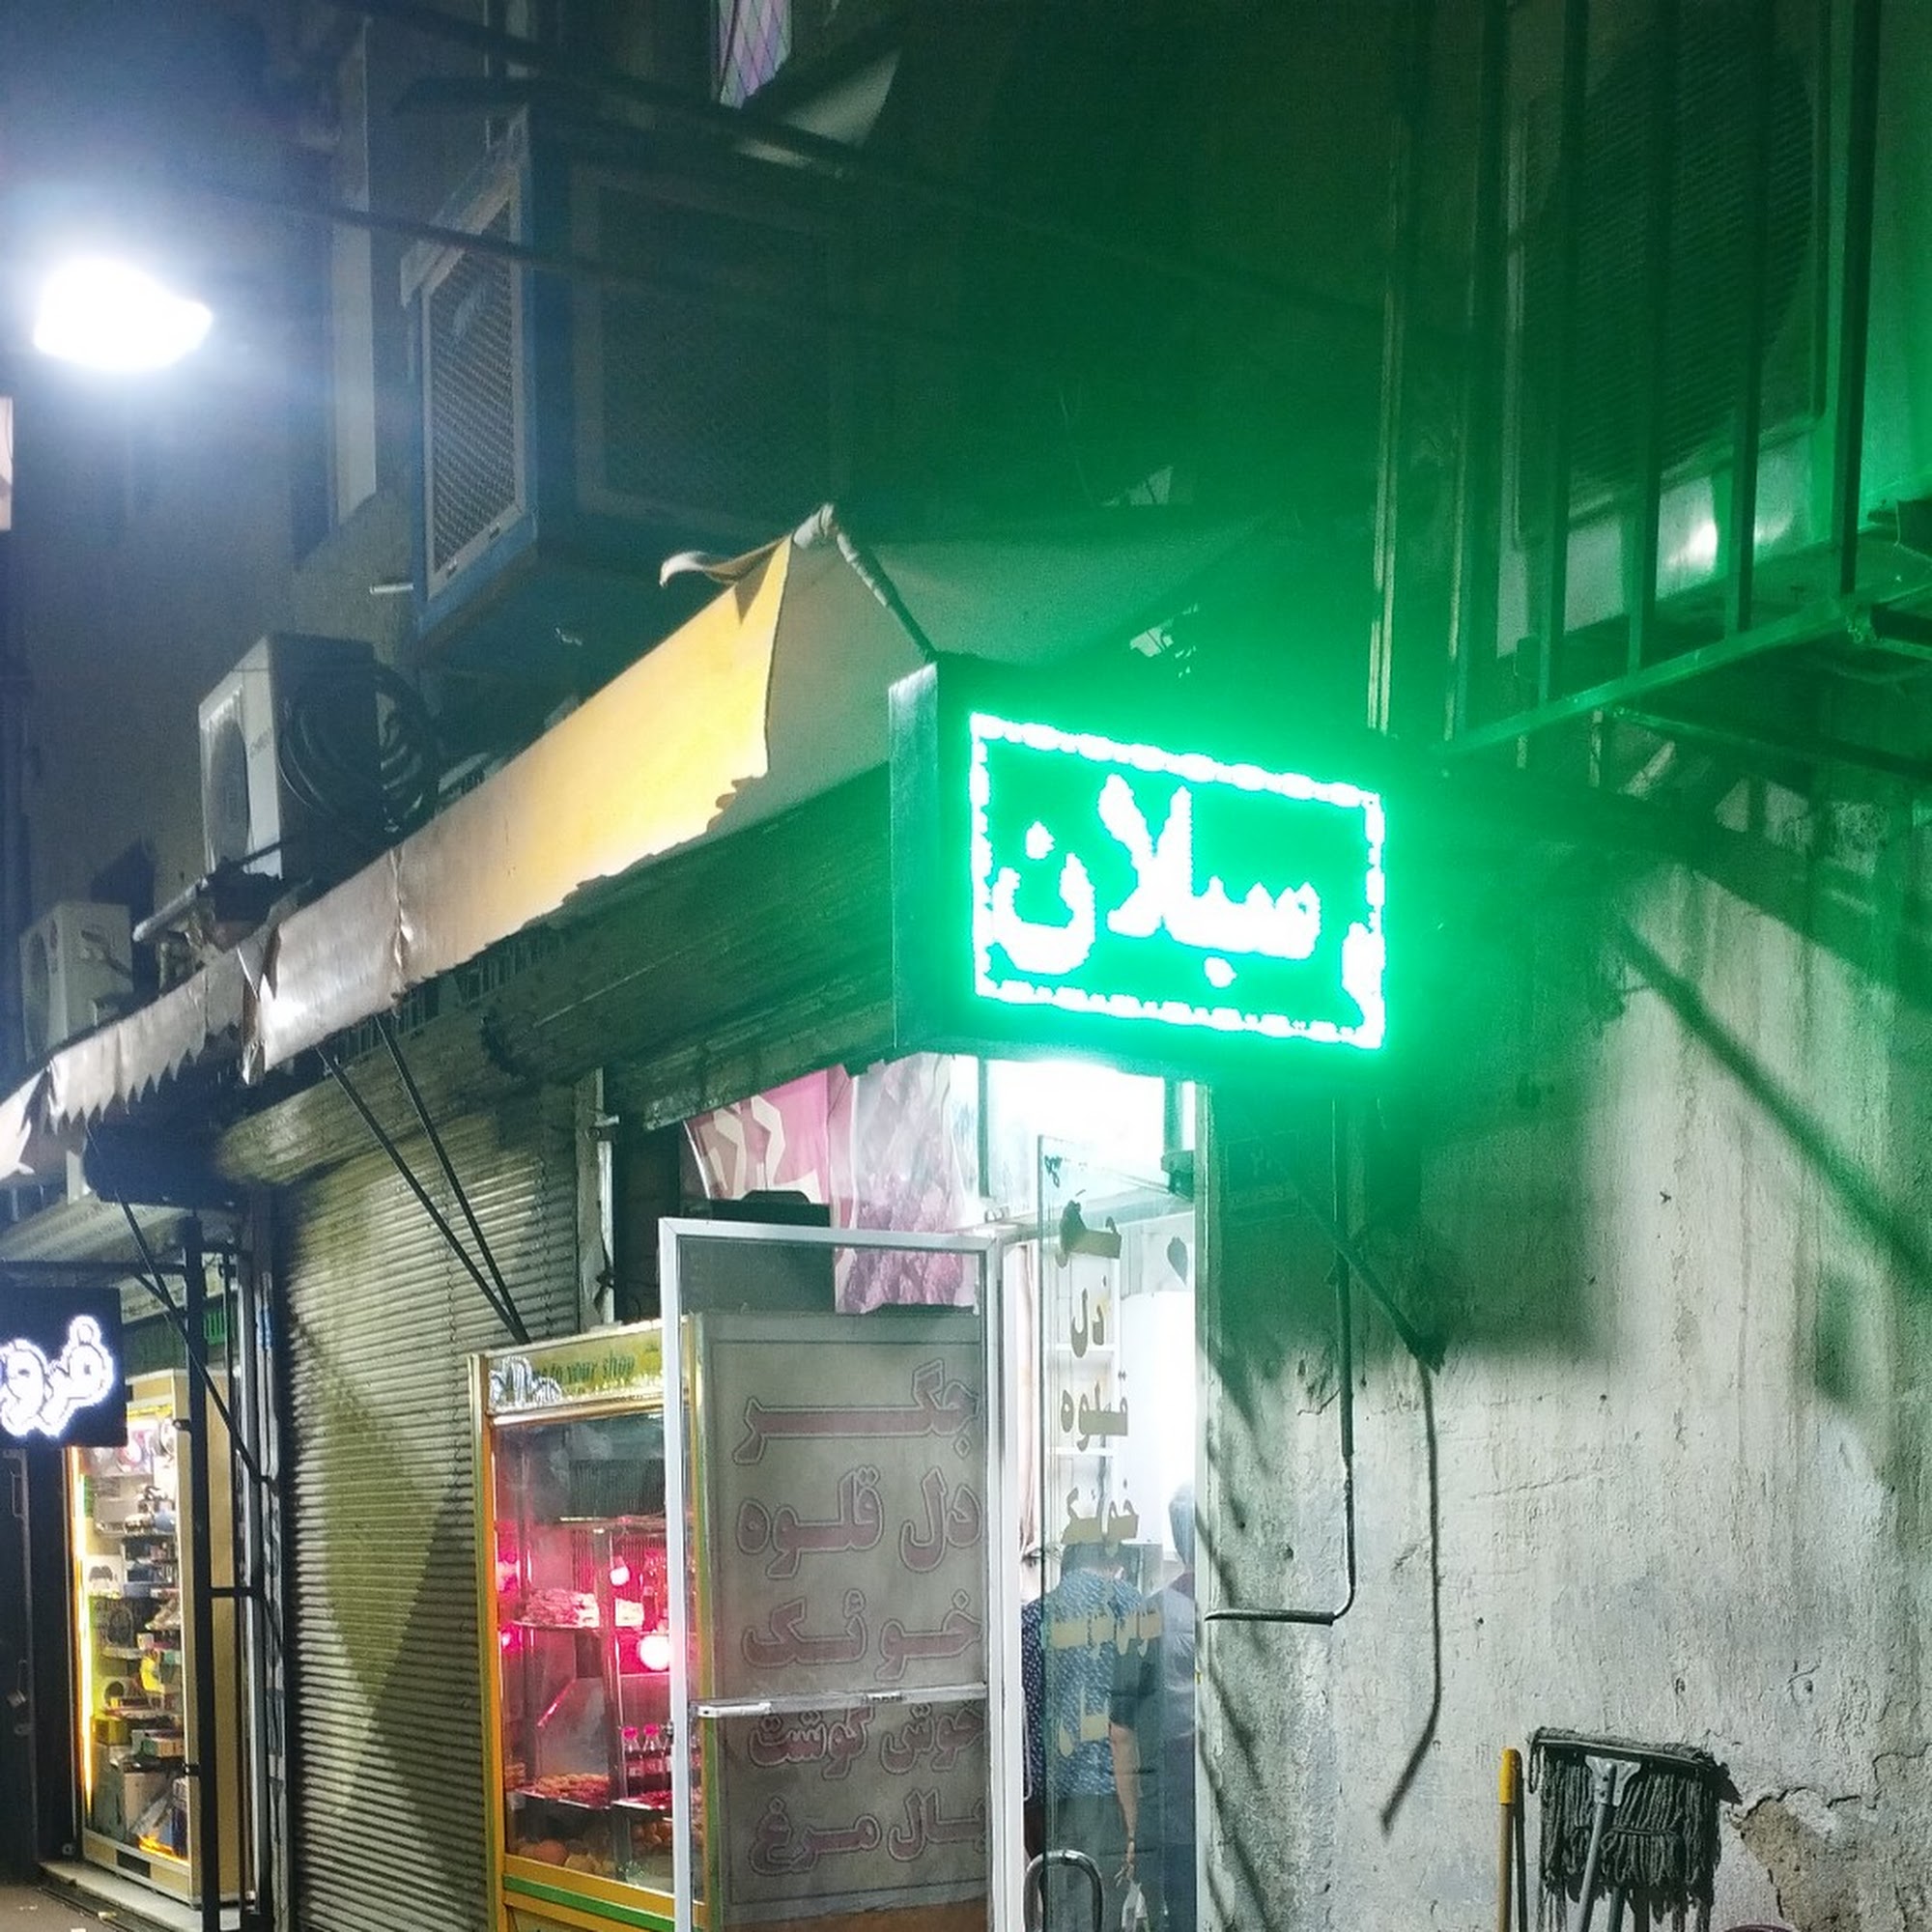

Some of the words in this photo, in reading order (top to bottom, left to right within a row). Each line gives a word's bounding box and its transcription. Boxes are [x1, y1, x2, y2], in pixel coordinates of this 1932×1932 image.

[732, 1358, 980, 1465] جگر
[736, 1465, 884, 1580] قلوه
[748, 1797, 883, 1876] مرغ
